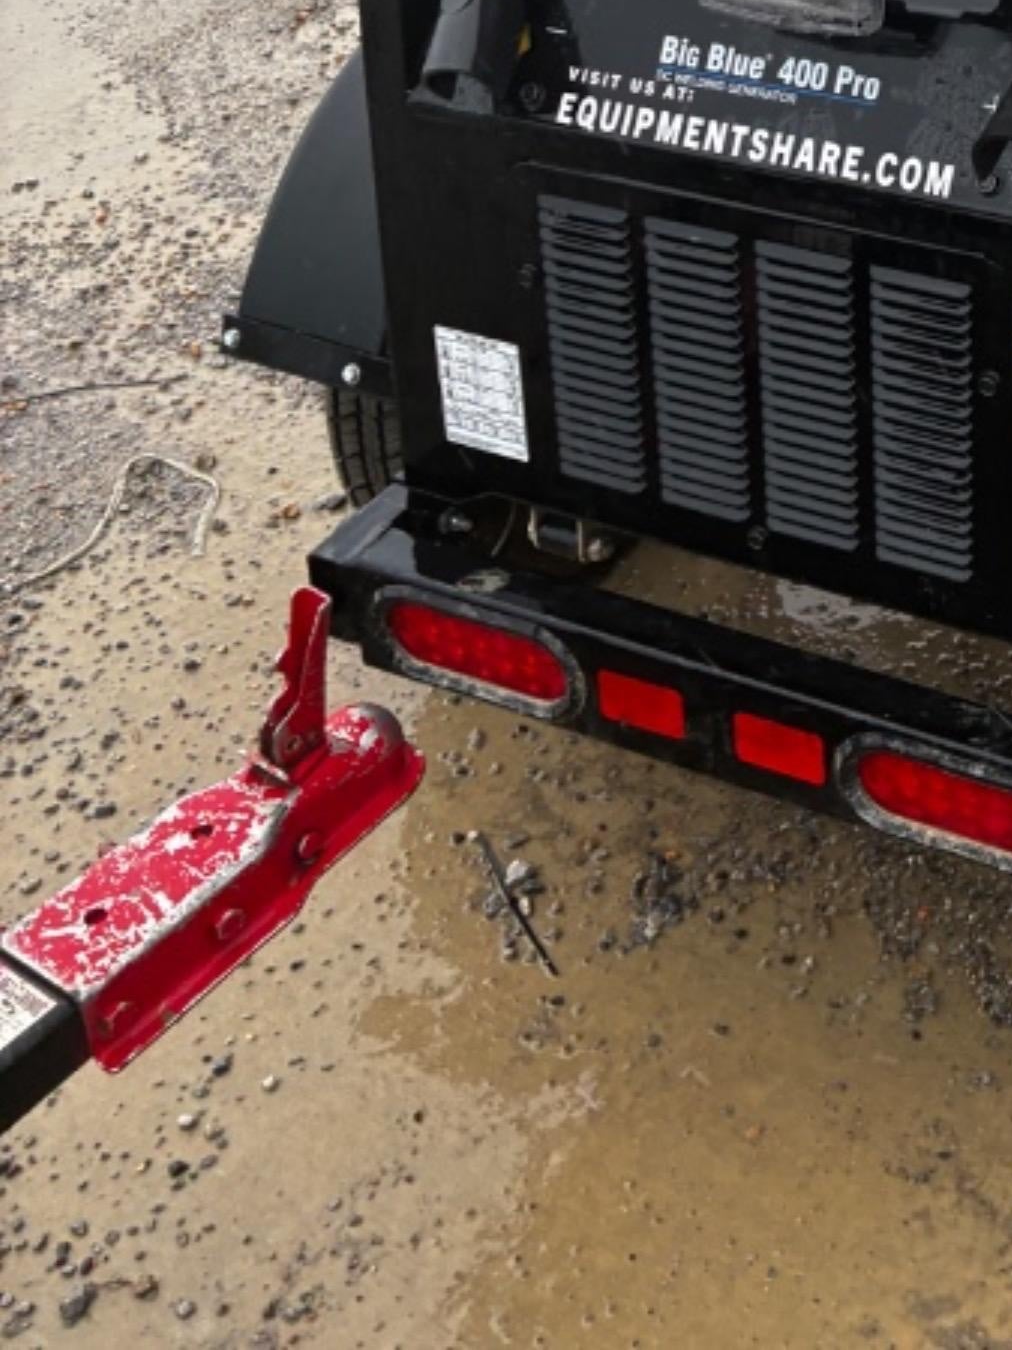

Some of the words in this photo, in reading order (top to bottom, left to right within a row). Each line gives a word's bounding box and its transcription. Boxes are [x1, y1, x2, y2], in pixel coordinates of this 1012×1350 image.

[568, 65, 622, 89] VISIT
[628, 77, 656, 96] US
[661, 83, 696, 103] AT:
[776, 56, 829, 91] 400
[833, 65, 881, 100] Pro
[555, 91, 955, 199] EQUIPMENTSHARE.COM
